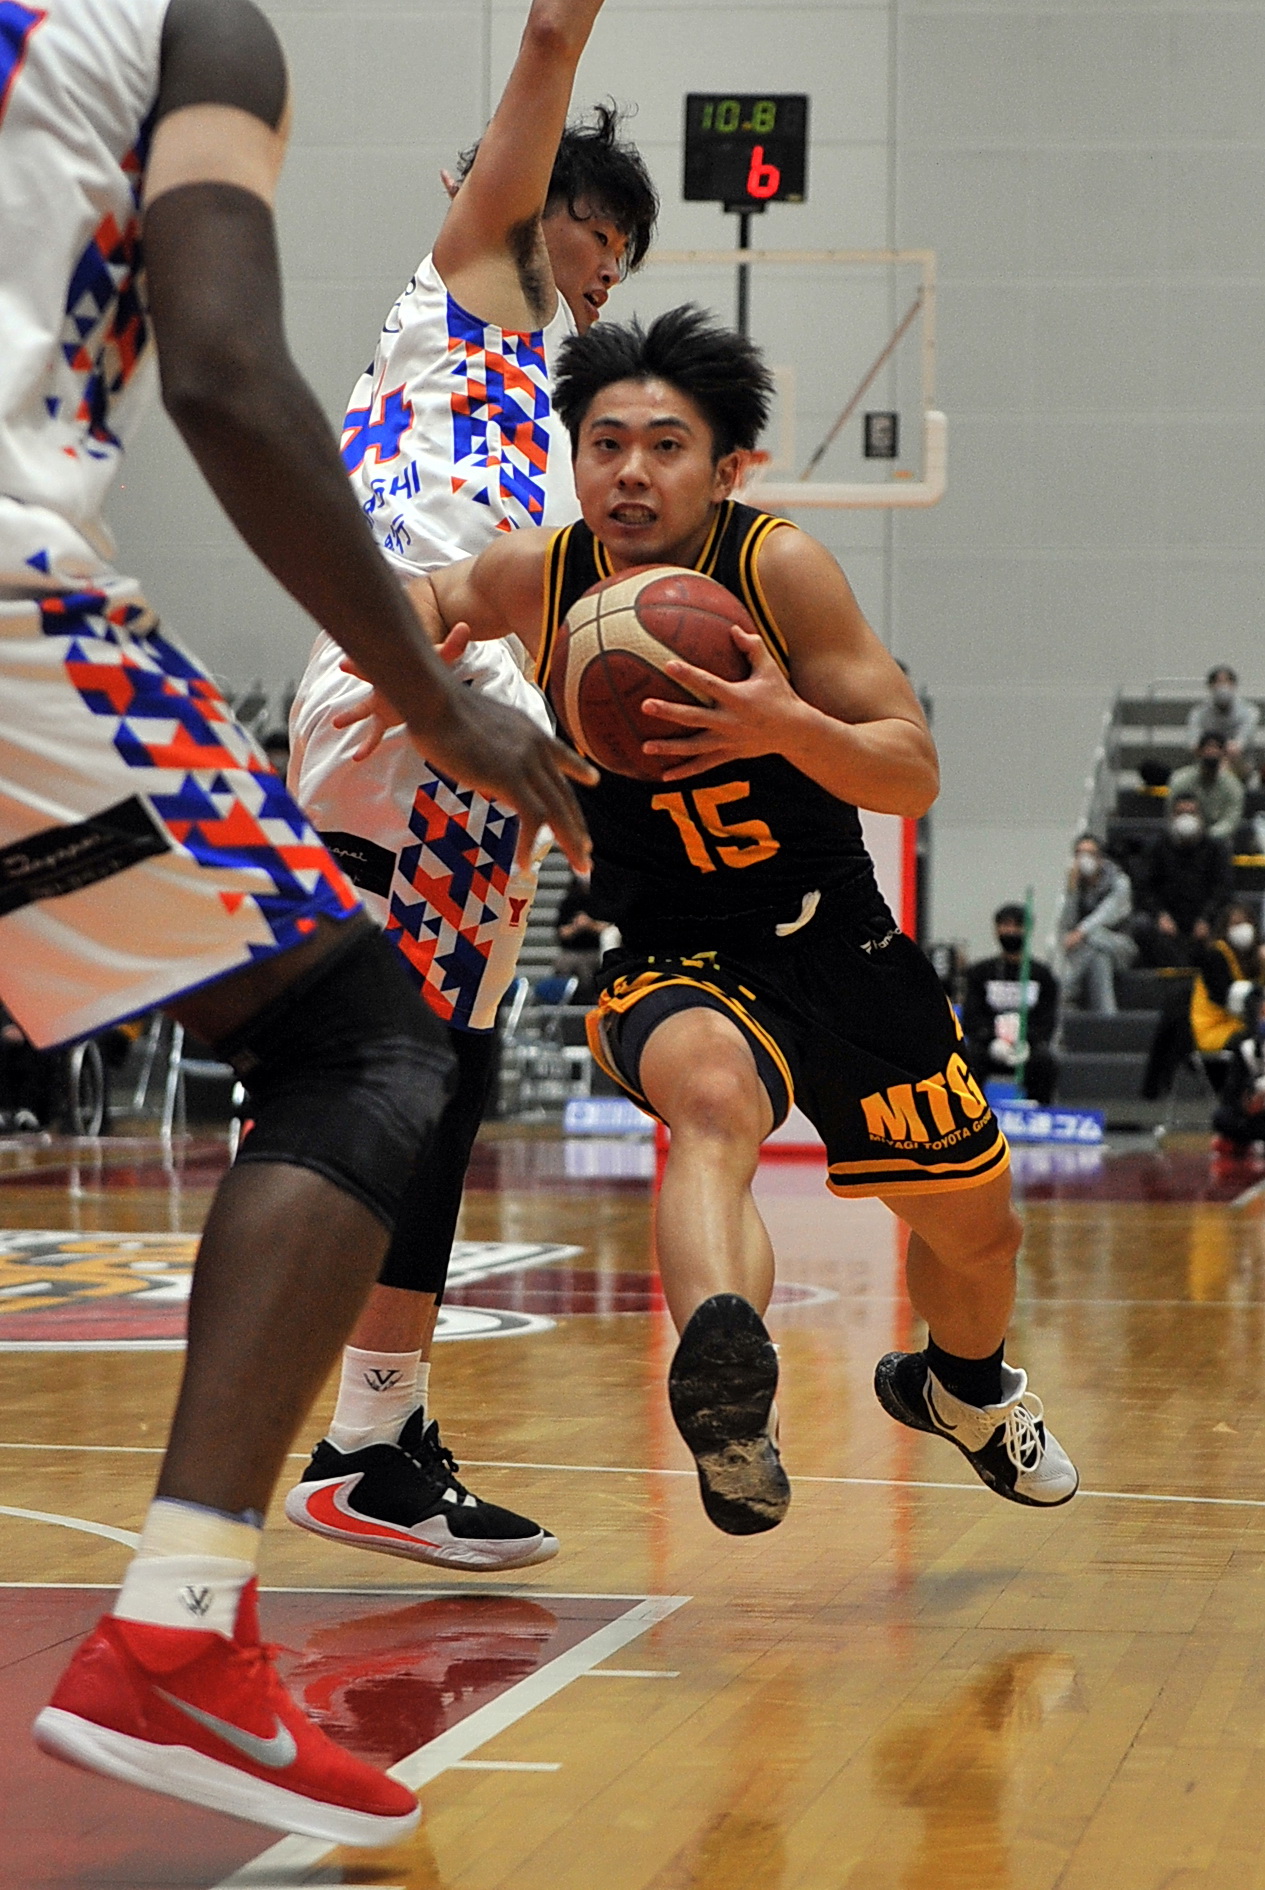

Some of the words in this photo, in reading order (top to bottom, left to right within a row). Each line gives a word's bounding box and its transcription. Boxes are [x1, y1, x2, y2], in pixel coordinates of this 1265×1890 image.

[702, 101, 776, 133] 10.8
[651, 781, 780, 874] 15
[860, 1052, 988, 1143] MTG
[923, 1127, 971, 1150] TOYOTA
